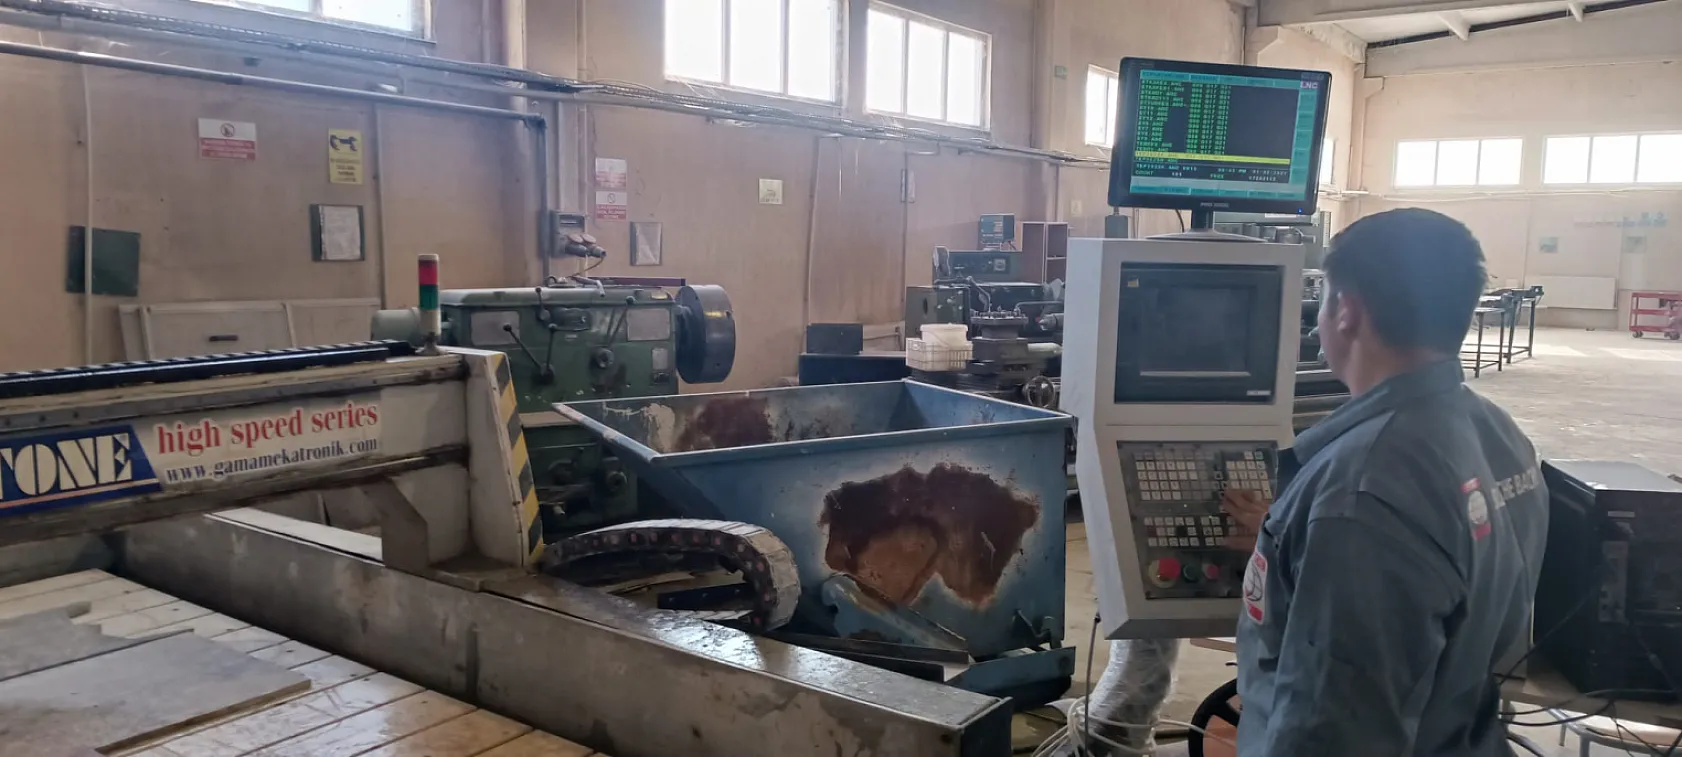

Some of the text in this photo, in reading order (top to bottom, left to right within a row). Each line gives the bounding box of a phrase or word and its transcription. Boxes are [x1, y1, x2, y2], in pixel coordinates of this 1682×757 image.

[158, 403, 378, 457] high speed series
[166, 437, 378, 483] www.gamamekatronik.com
